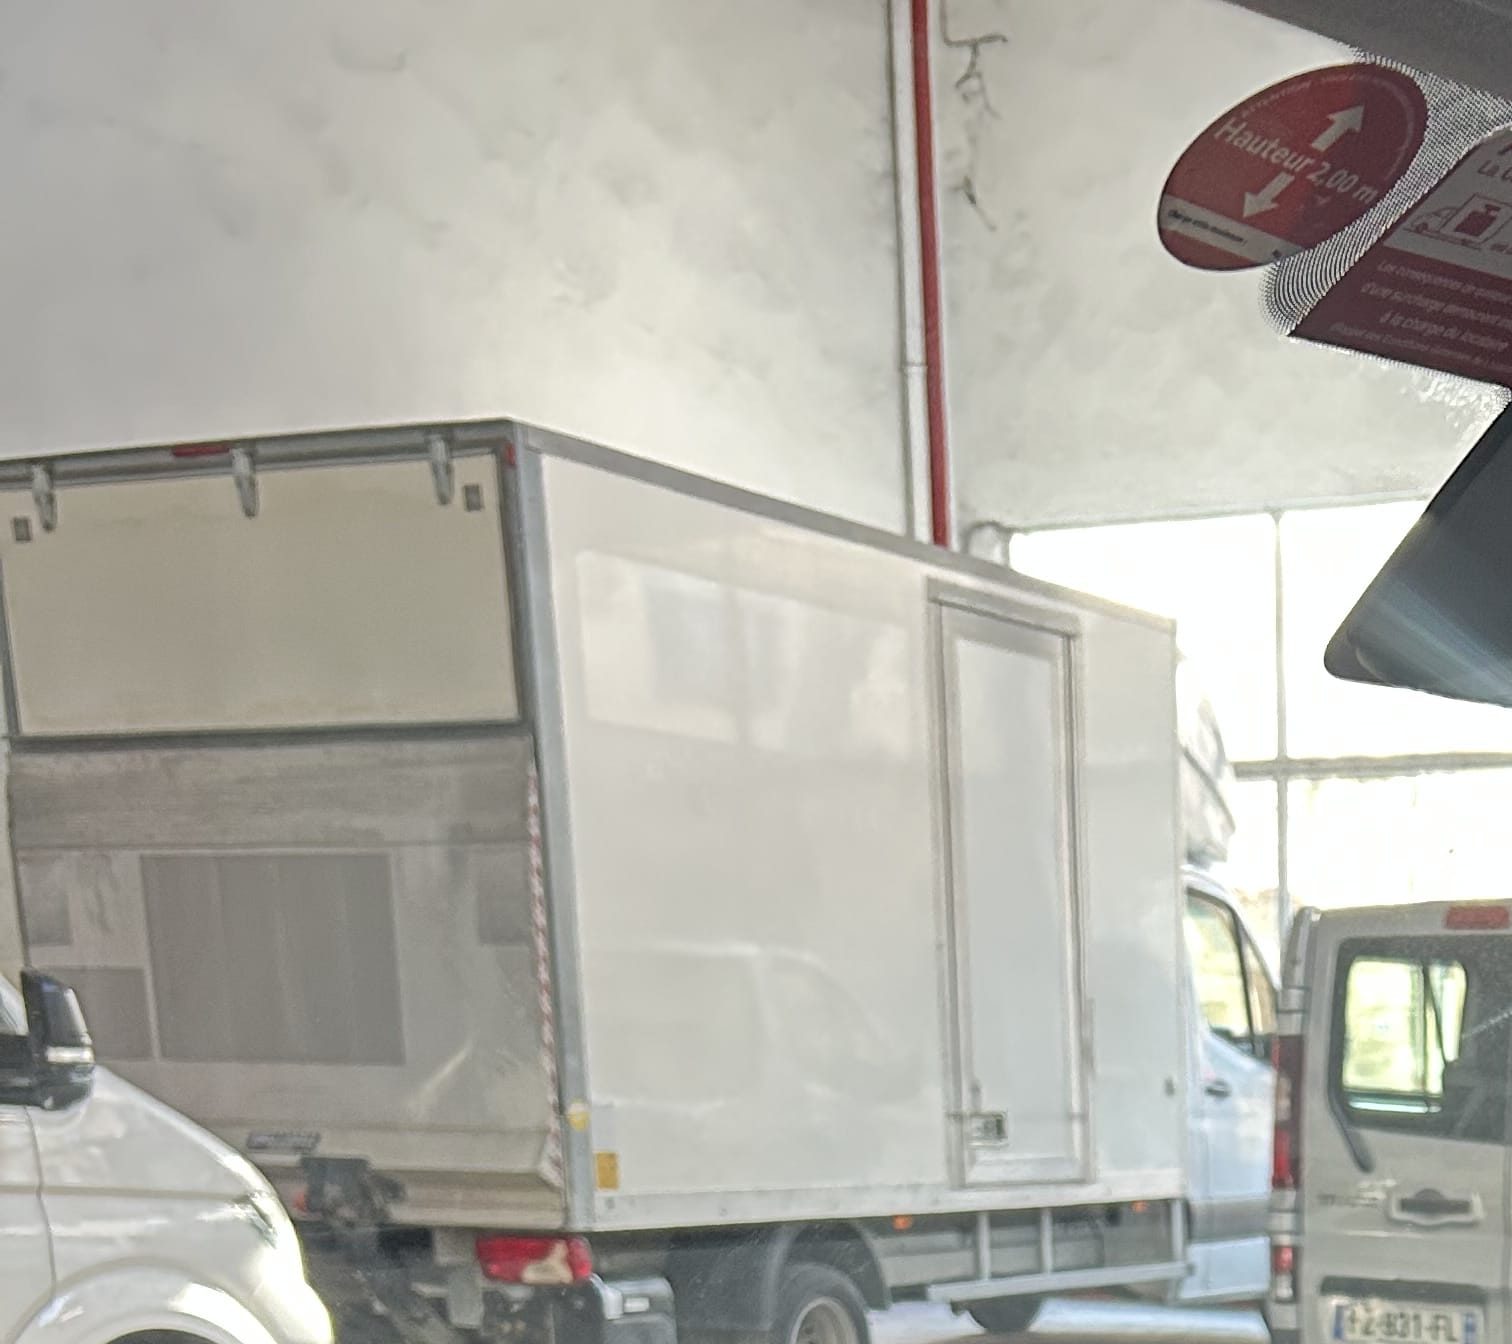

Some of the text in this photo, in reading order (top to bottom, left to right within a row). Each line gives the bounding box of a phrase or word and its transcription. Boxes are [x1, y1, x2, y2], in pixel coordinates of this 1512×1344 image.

[1213, 117, 1378, 204] Hauteur 2,00 m
